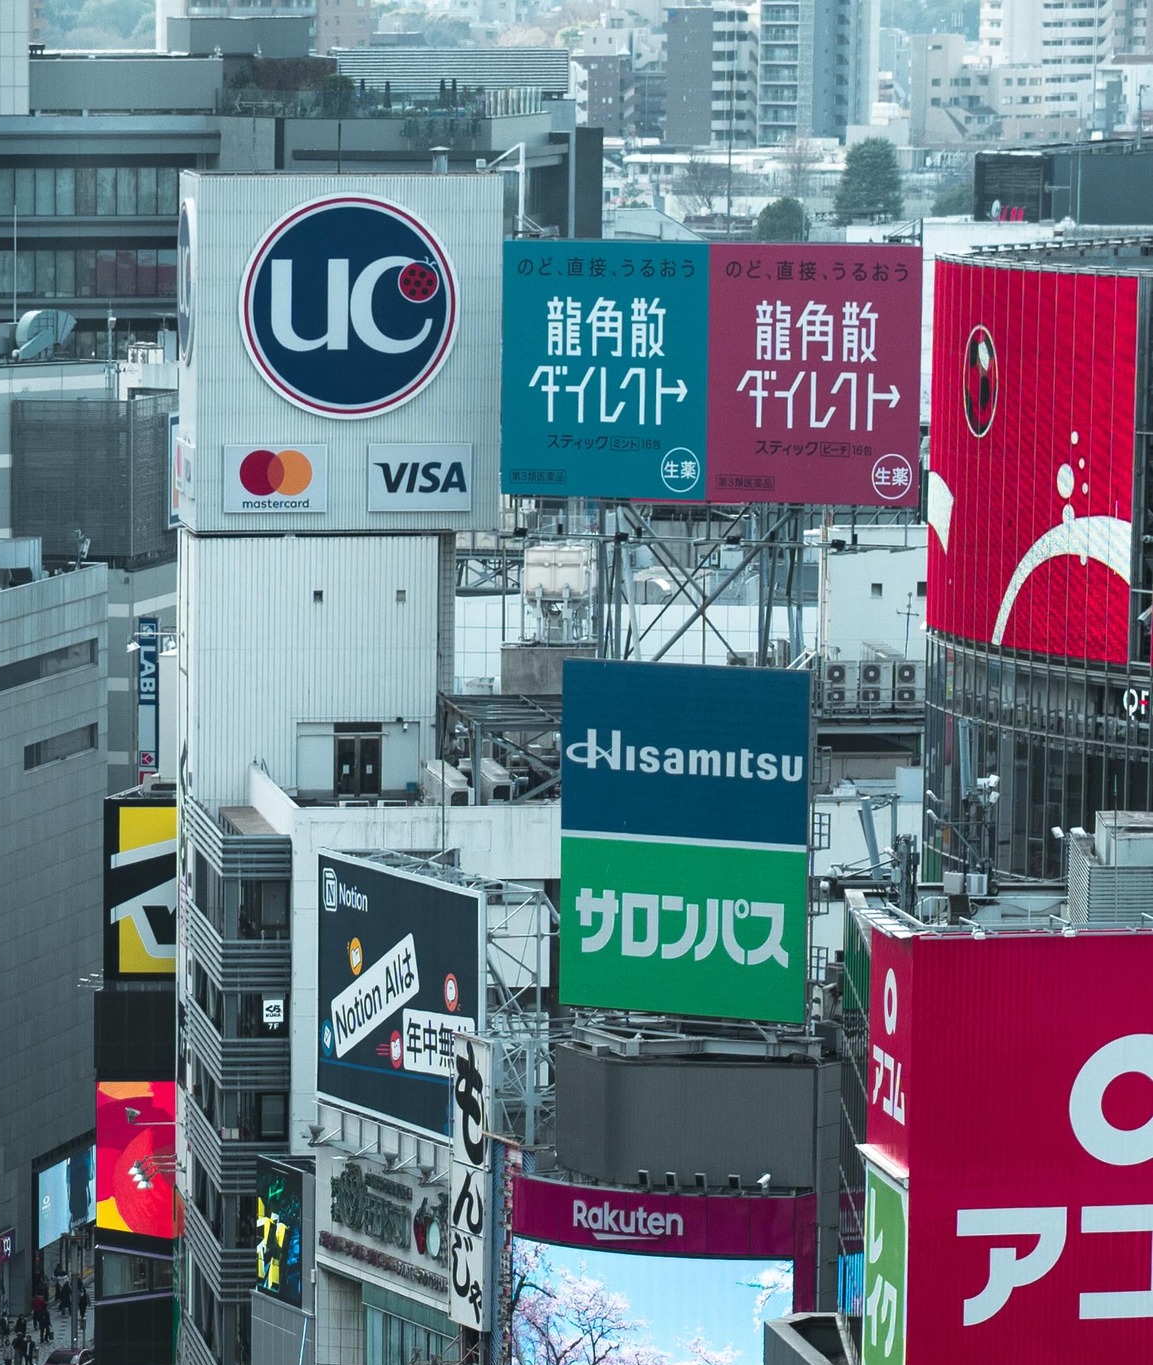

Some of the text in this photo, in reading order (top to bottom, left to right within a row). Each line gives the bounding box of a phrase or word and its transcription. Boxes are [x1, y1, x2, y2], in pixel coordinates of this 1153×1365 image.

[517, 257, 697, 279] のど、直接、うるおう
[725, 260, 910, 282] のど、直接、うるおう
[547, 296, 667, 360] 龍角散
[756, 300, 879, 364] 龍角散
[528, 364, 689, 426] ダイレクト
[736, 370, 901, 432] ダイレクト
[547, 433, 609, 451] スティック
[754, 440, 819, 457] スティック
[372, 460, 468, 494] VISA
[663, 459, 697, 480] 生薬
[874, 466, 909, 487] 生薬
[241, 498, 310, 510] mastercard
[139, 645, 156, 700] LABI
[565, 727, 803, 782] Hisamitsu
[339, 881, 369, 913] Notion
[575, 887, 791, 970] サロンパス
[333, 984, 382, 1046] Notion
[872, 1043, 906, 1127] アコム
[573, 1199, 684, 1236] Rakuten
[867, 1186, 899, 1359] レイク
